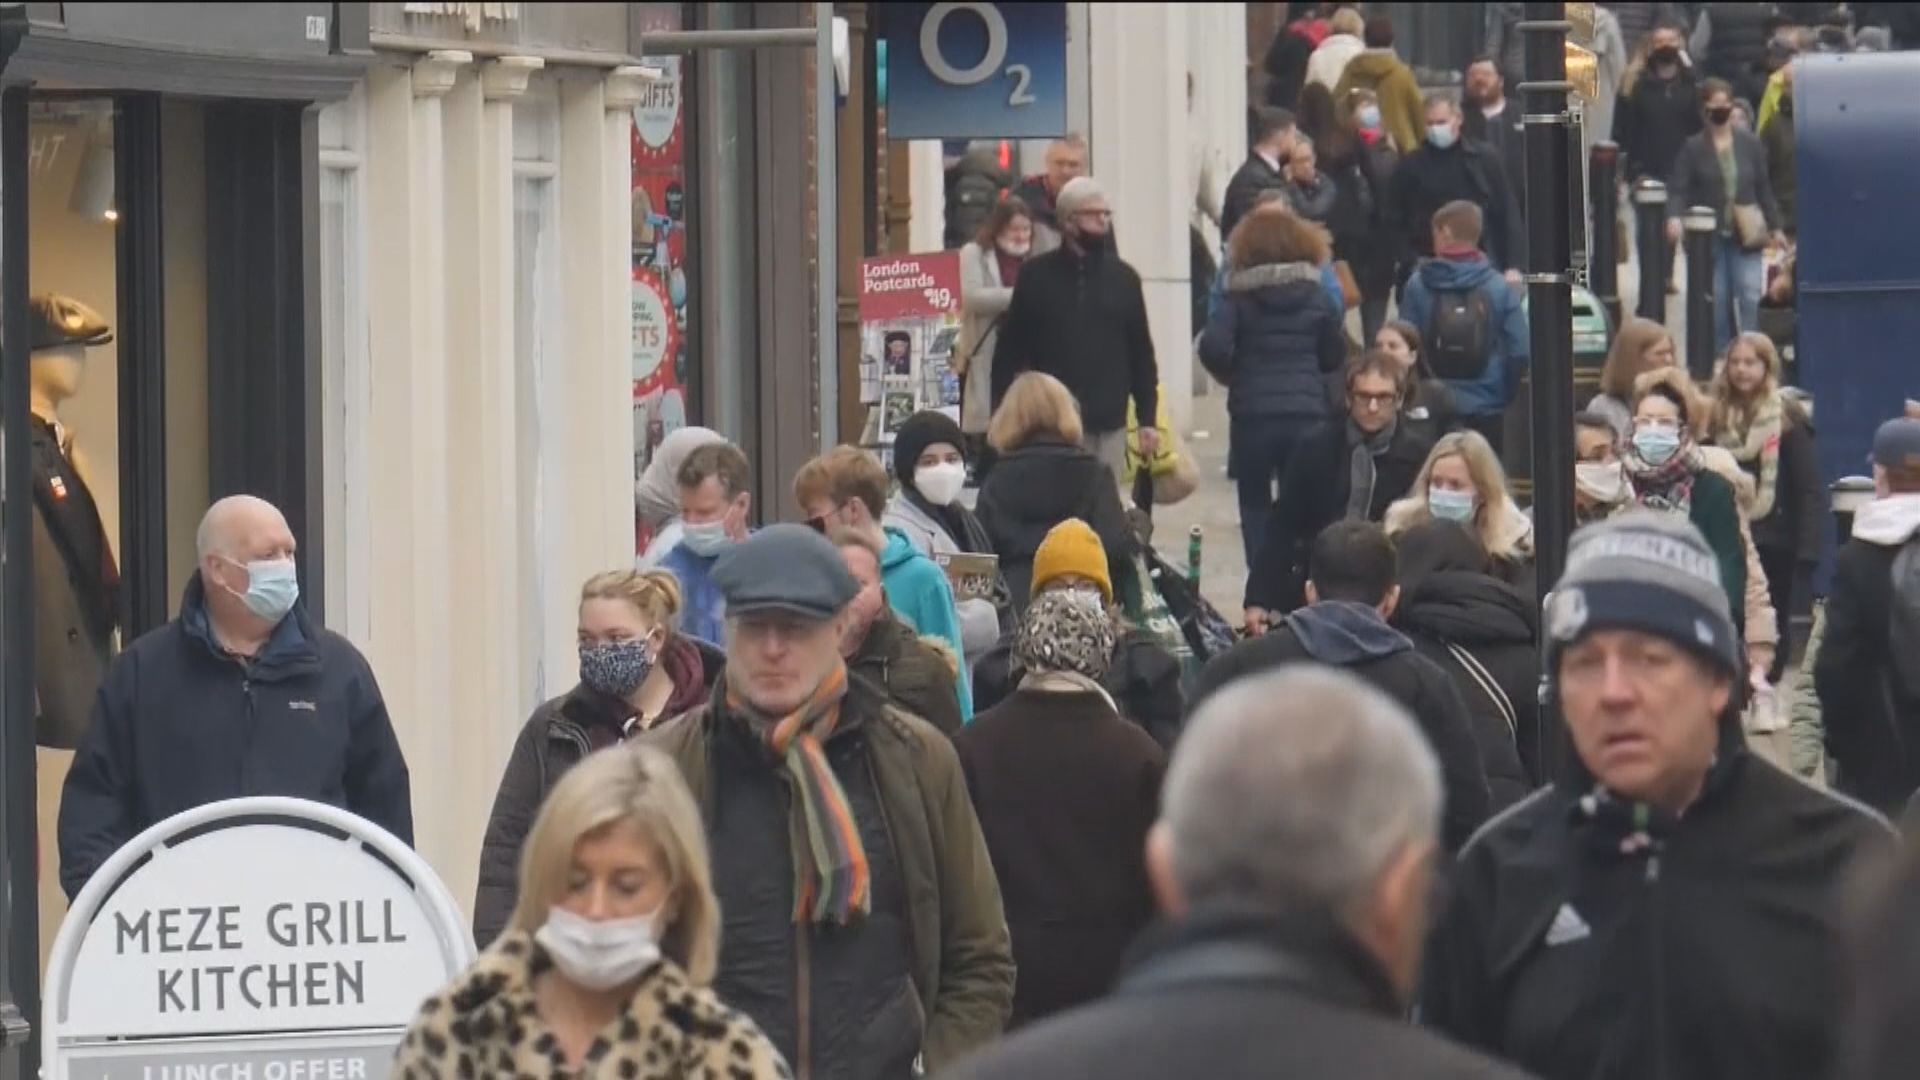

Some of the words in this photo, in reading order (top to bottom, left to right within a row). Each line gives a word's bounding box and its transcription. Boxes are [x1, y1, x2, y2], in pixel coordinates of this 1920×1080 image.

[863, 260, 920, 279] London
[864, 273, 935, 293] Postcards
[114, 905, 243, 955] MEZE
[266, 898, 407, 947] GRILL
[157, 960, 364, 1013] KITCHEN
[143, 1062, 253, 1080] LUNCH
[263, 1057, 367, 1080] OFFER
